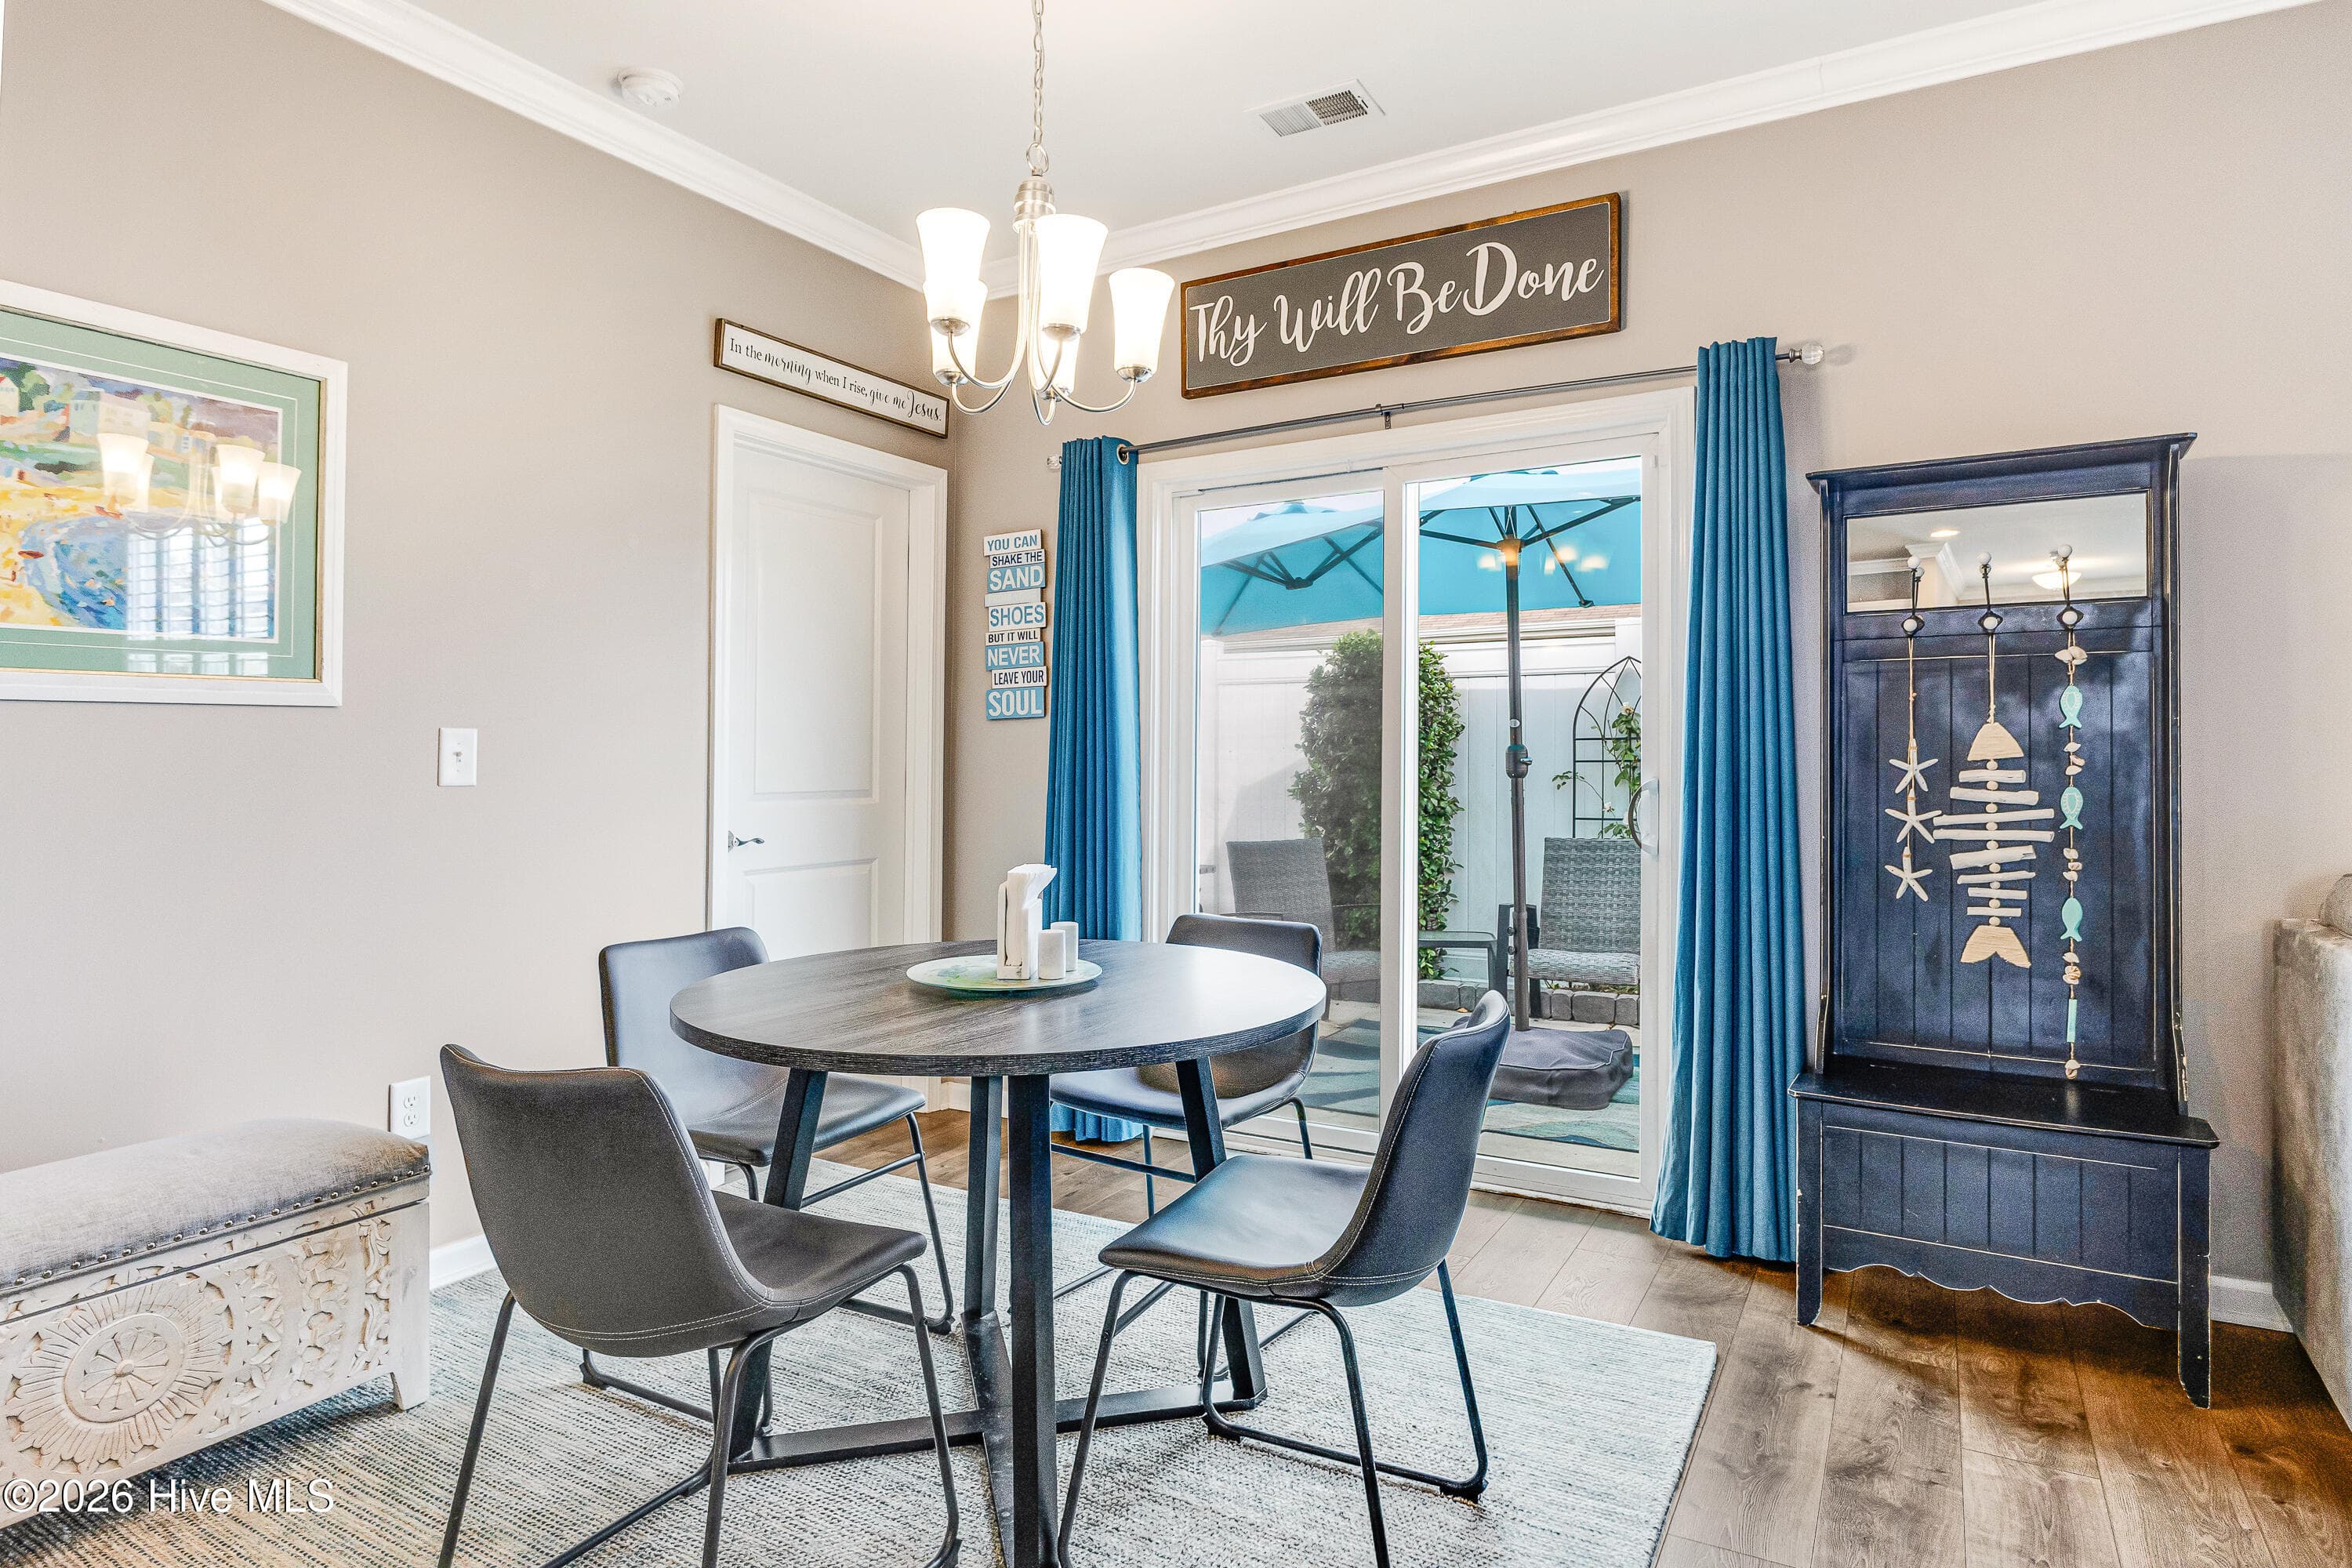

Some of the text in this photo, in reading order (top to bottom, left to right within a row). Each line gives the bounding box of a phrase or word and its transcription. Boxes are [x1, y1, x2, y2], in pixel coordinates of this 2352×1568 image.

[1189, 241, 1604, 367] Thy Will Be Done
[730, 337, 942, 422] In the morning when I rise, give me Jesus.
[987, 535, 1037, 551] YOU CAN
[992, 551, 1043, 567] SHAKE THE
[990, 566, 1042, 590] SAND
[990, 605, 1044, 626] SHOES
[988, 630, 1038, 644] BUT IT WILL
[989, 647, 1040, 666] NEVER
[993, 670, 1044, 685] LEAVE YOUR
[989, 691, 1041, 716] SOUL
